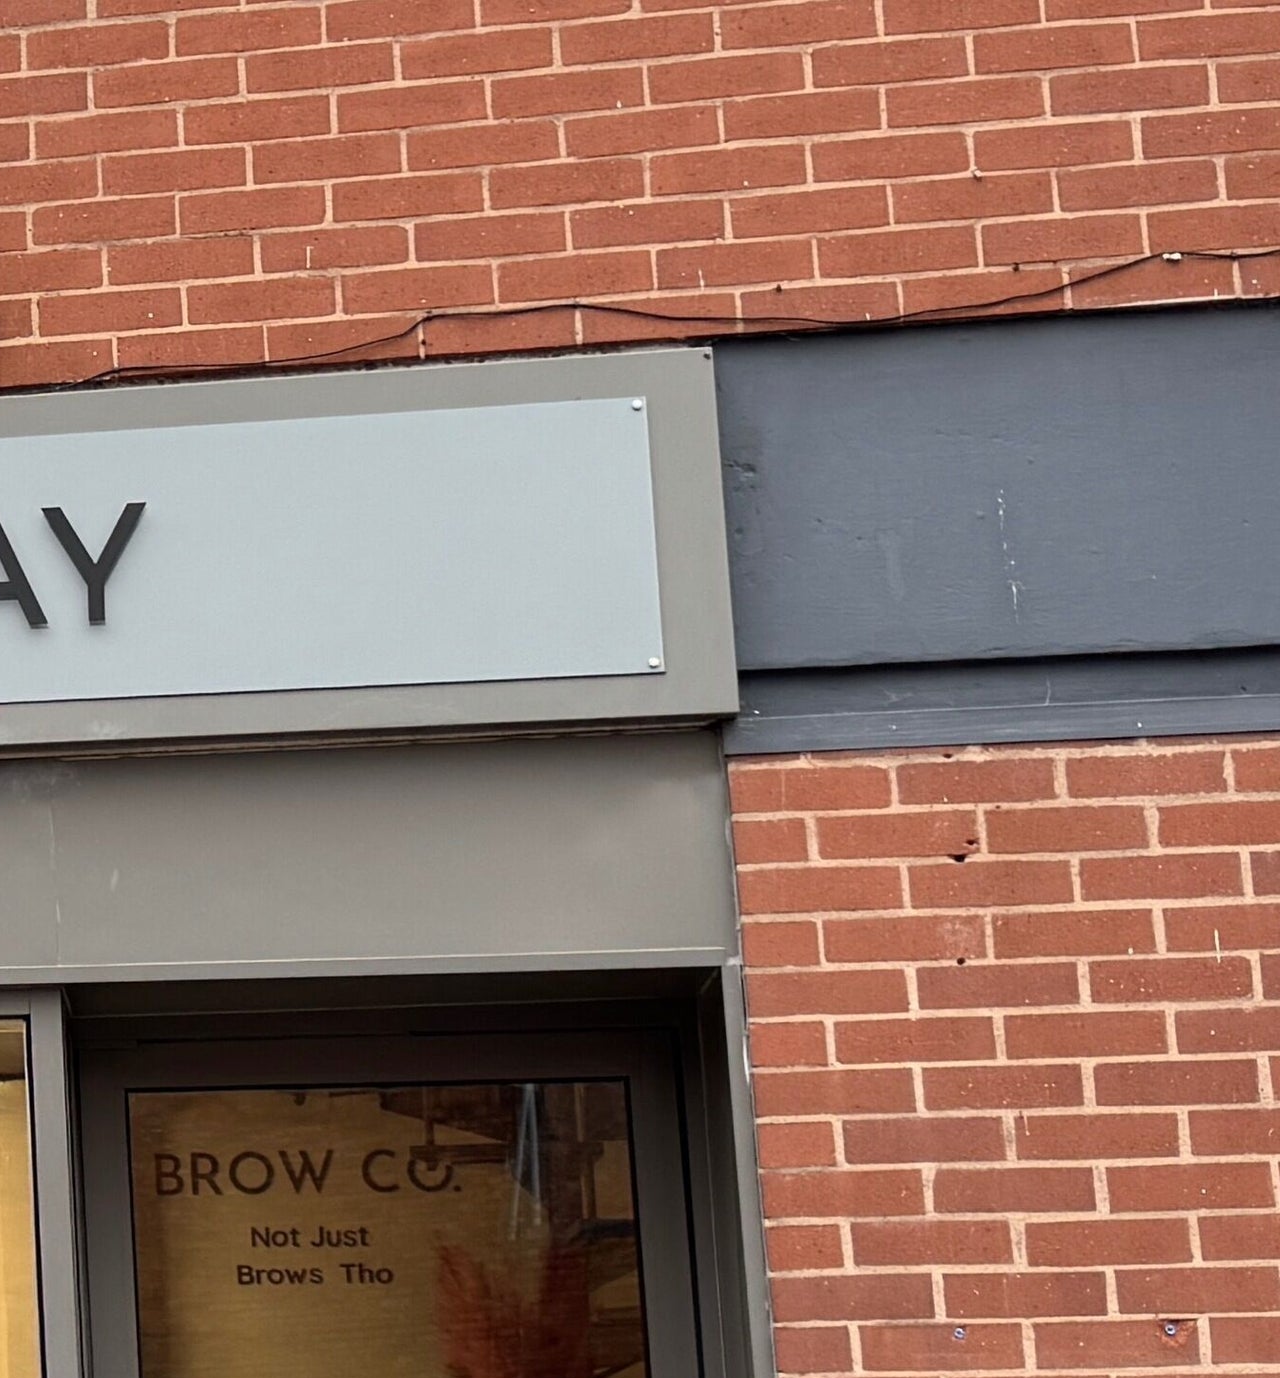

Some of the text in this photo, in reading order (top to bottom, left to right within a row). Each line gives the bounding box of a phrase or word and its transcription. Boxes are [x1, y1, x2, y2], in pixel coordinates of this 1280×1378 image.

[153, 1149, 334, 1196] BROW
[250, 1225, 370, 1248] Not Just
[236, 1262, 395, 1286] Brows Tho
